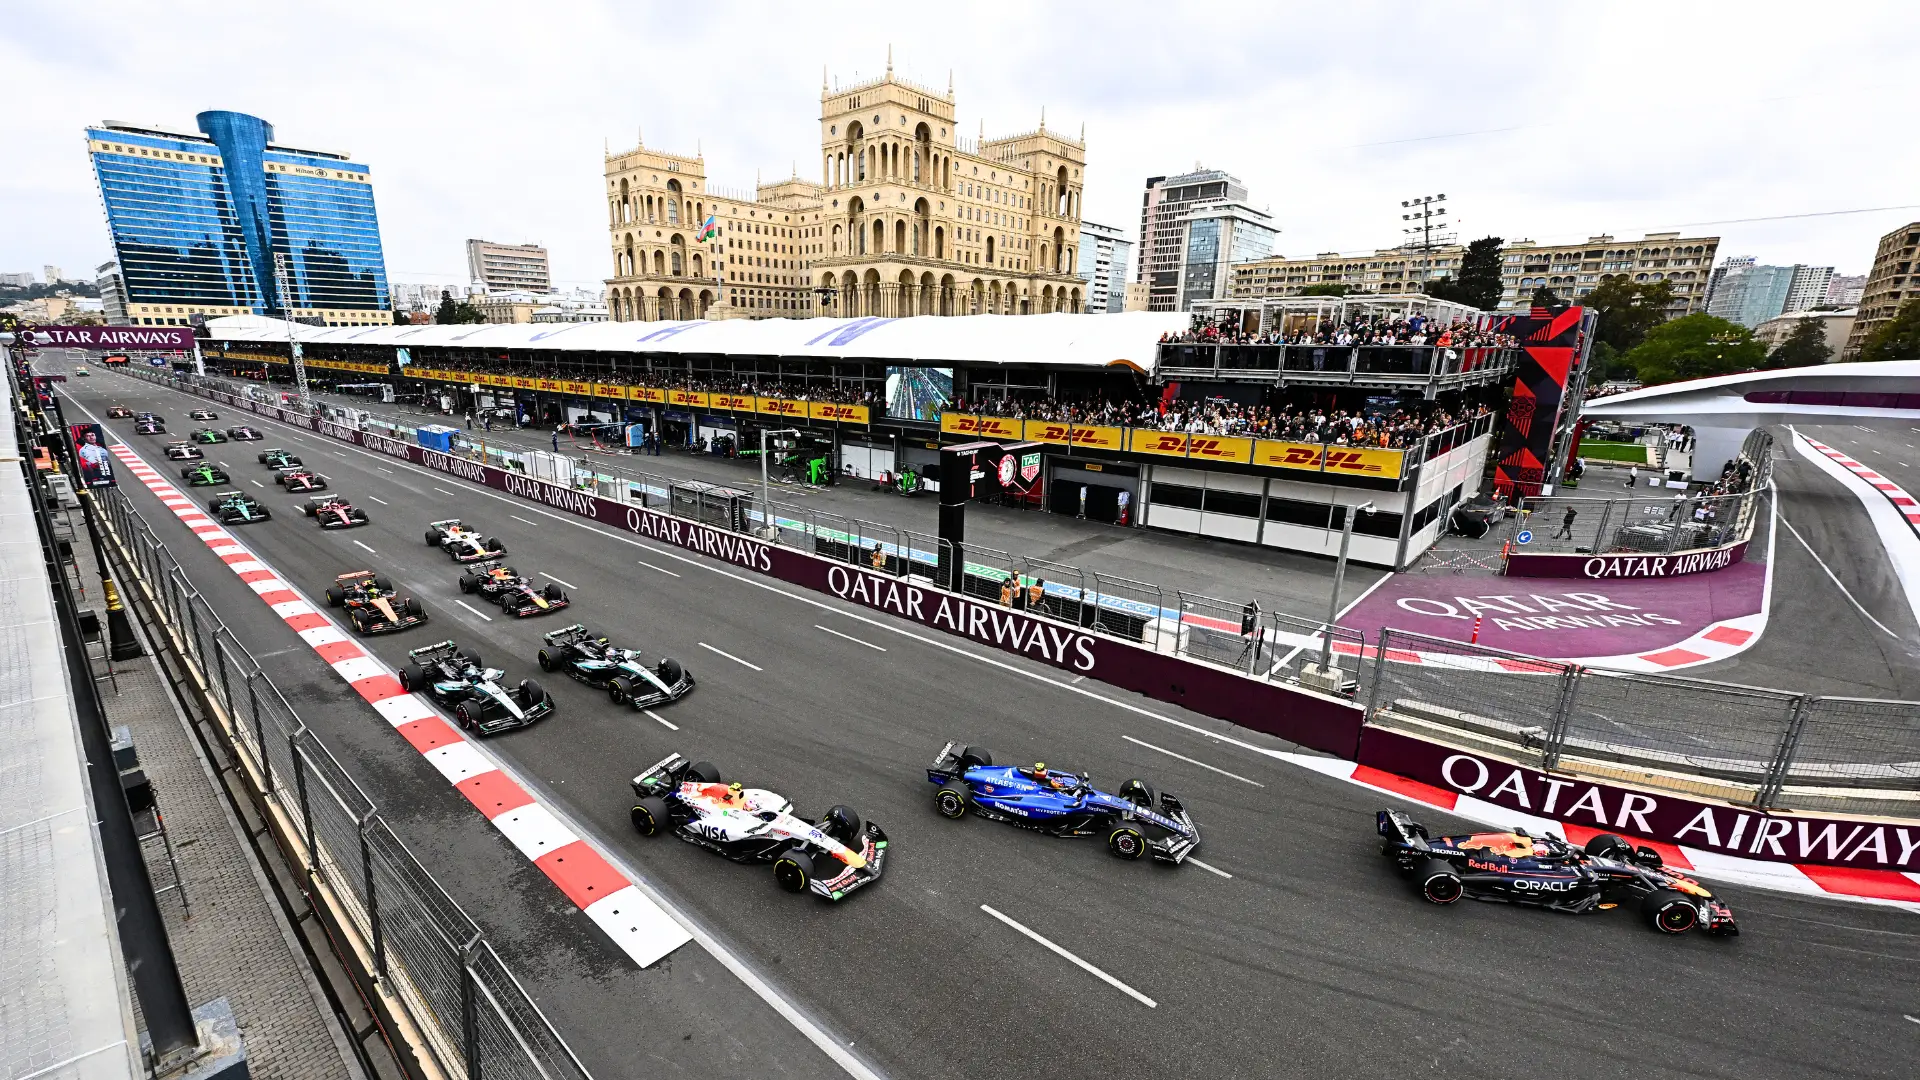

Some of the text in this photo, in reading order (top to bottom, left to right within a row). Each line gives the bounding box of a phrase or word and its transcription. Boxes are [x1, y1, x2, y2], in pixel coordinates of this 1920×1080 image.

[100, 331, 182, 344] AIRWAYS
[542, 382, 557, 390] DHL
[568, 384, 586, 392] DHL
[600, 386, 620, 396] DHL
[636, 390, 657, 400] DHL
[677, 394, 700, 404] DHL
[720, 398, 746, 408] DHL
[768, 401, 798, 414] DHL
[822, 406, 858, 419] DHL
[318, 421, 334, 436] QATAR
[957, 418, 1005, 434] DHL
[1043, 426, 1099, 444] DHL
[363, 434, 410, 460] QATAR AIRWAYS
[1157, 436, 1224, 456] DHL
[1024, 456, 1039, 465] TAG
[1286, 448, 1364, 469] DHL
[423, 451, 486, 483] QATAR AIRWAYS
[505, 474, 597, 517] QATAR AIRWAYS
[627, 508, 682, 545] QATAR
[687, 525, 771, 572] AIRWAYS
[1584, 548, 1732, 578] QATAR AIRWAYS
[1396, 592, 1641, 620] QATAR
[828, 566, 1097, 671] QATAR AIRWAYS
[1492, 613, 1681, 632] AIRWAYS
[986, 776, 1027, 792] ATLASSIAN
[1442, 754, 1656, 833] QATAR
[995, 801, 1028, 817] KOMATSU
[698, 823, 730, 842] VISA
[1432, 848, 1466, 857] HONDA
[1468, 859, 1508, 874] Red Bull
[1514, 880, 1578, 892] ORACLE
